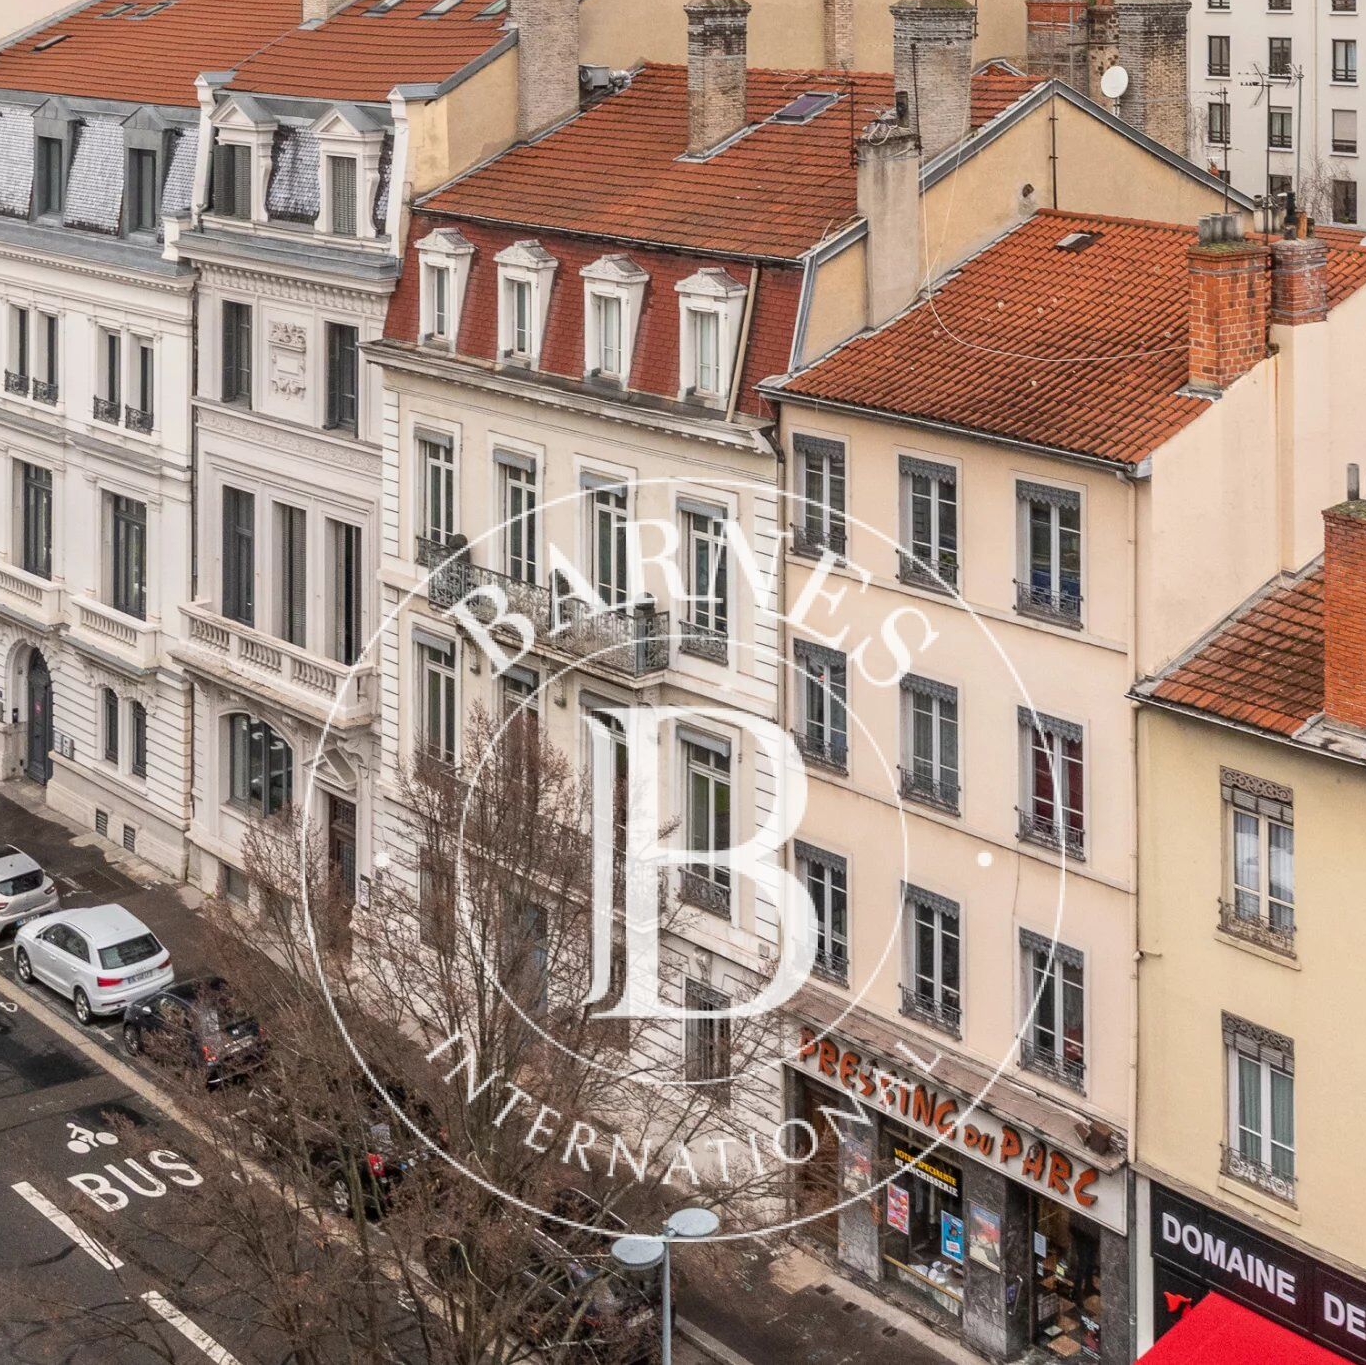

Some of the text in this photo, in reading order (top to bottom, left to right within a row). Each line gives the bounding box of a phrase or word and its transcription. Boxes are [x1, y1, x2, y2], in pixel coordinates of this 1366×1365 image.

[66, 1149, 204, 1213] BUS
[798, 1027, 1100, 1208] PRESSING DU PARC
[1161, 1212, 1297, 1305] DOMAINE
[1323, 1291, 1366, 1341] DE
